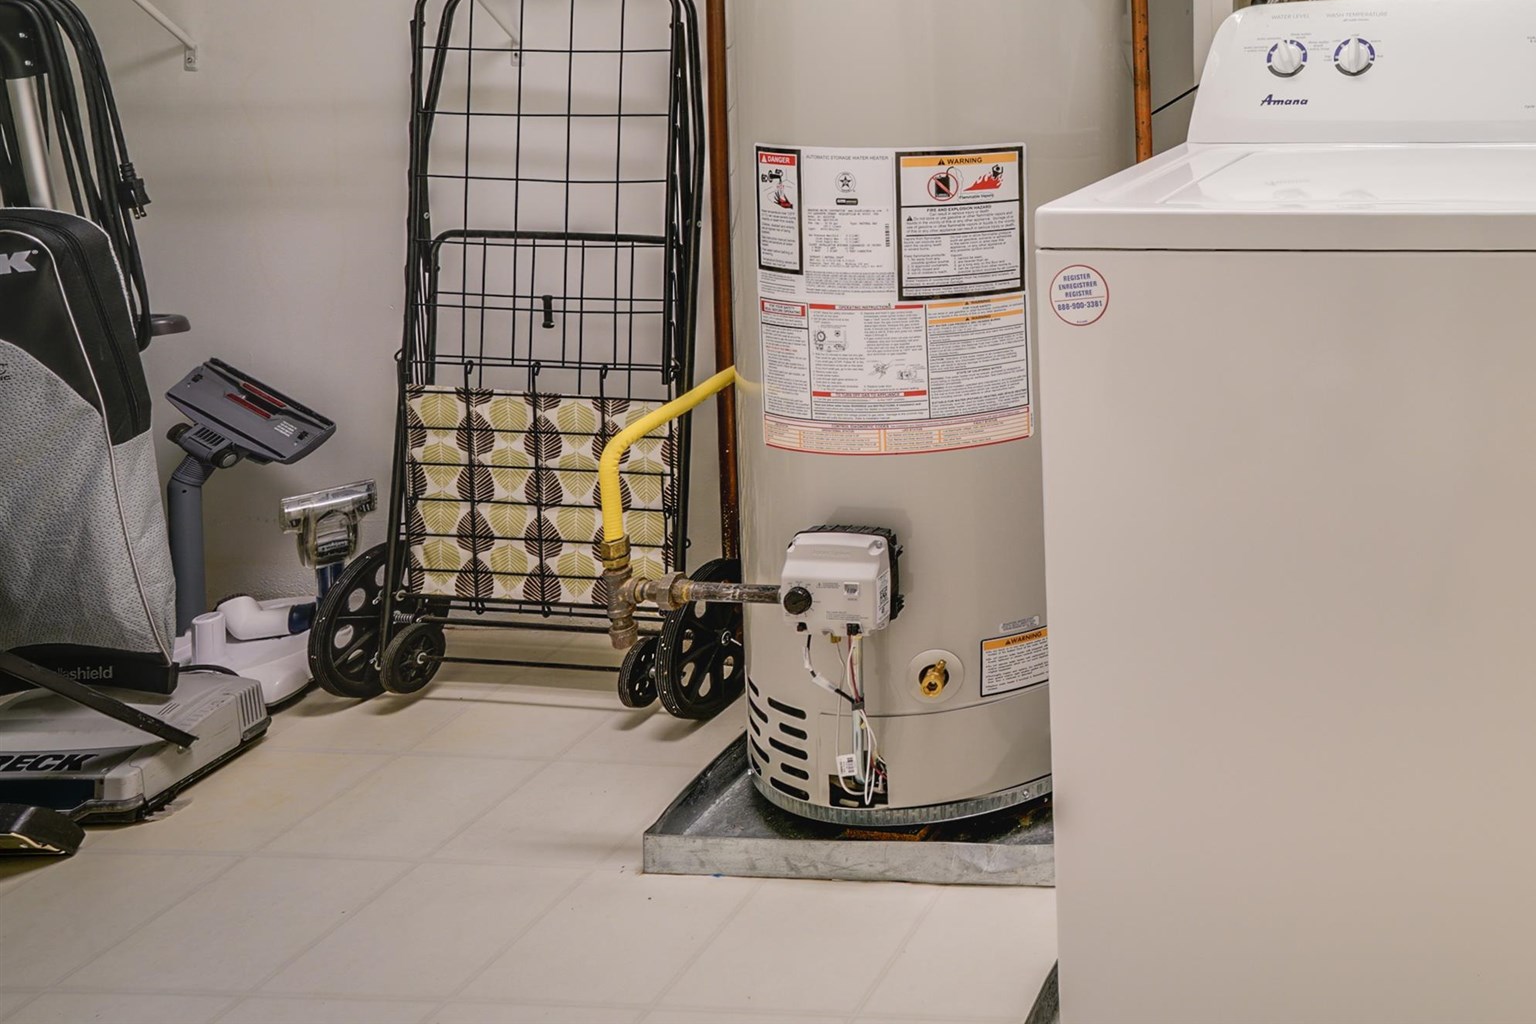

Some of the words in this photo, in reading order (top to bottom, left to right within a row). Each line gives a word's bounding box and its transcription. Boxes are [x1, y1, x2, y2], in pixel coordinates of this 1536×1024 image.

[1260, 93, 1309, 106] Amana
[767, 156, 791, 164] DANGER
[947, 157, 983, 165] WARNING
[1063, 273, 1091, 281] REGISTER
[1011, 631, 1043, 644] WARNING
